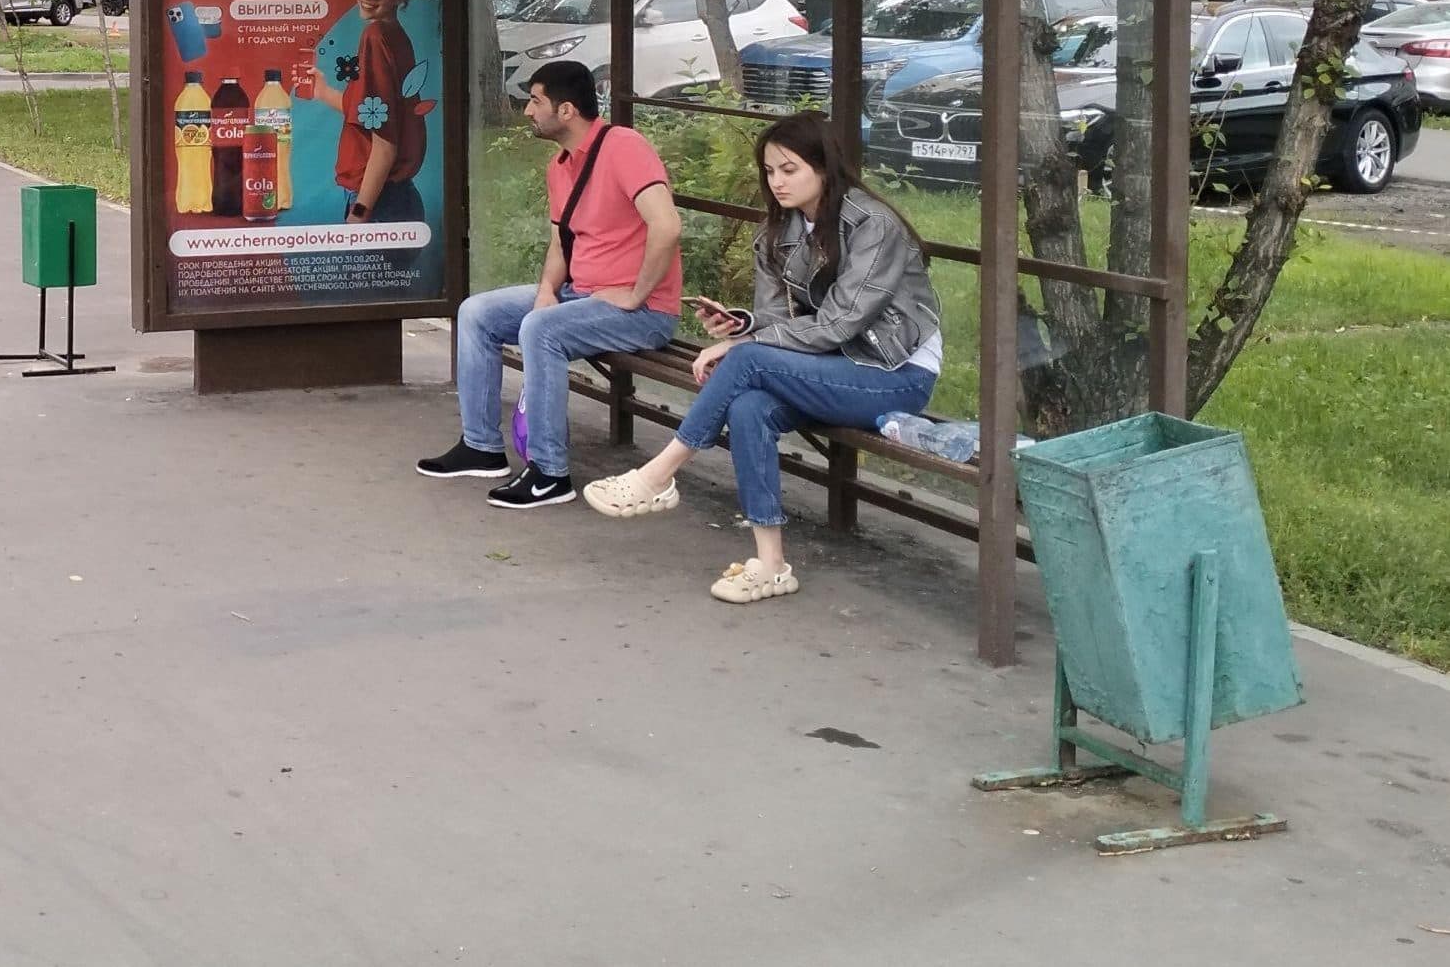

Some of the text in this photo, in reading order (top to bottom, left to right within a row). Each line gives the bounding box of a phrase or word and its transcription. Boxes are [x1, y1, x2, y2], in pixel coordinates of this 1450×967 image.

[238, 1, 321, 15] ВЫИГРЫВАЙ
[237, 22, 320, 34] стильный мерч
[237, 36, 296, 45] и гаджеты
[216, 126, 244, 139] Cola
[245, 177, 274, 192] Cola
[187, 230, 417, 249] www.chernogolovka-promo.ru
[177, 261, 200, 271] СРОК
[202, 259, 253, 270] ПРОВЕДЕНИЯ
[255, 258, 282, 268] АКЦИИ
[177, 269, 238, 280] ПОДРОБНОСТИ
[239, 268, 250, 277] ОБ
[252, 266, 311, 276] ОРГАНИЗАТОРЕ
